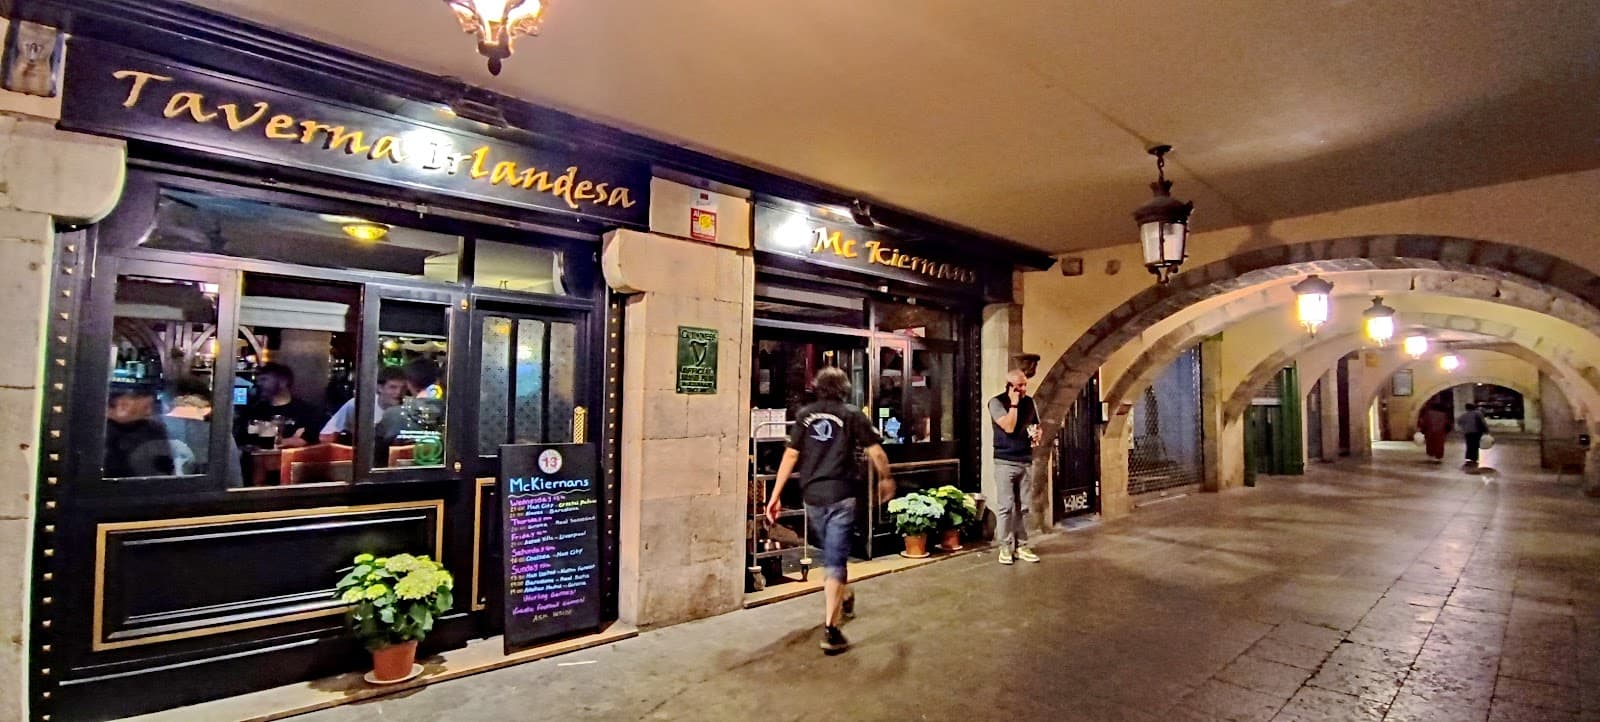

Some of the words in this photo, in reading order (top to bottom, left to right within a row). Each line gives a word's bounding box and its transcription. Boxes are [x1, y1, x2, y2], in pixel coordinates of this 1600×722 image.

[112, 69, 409, 163] Taverna
[422, 142, 636, 209] Irlandesa
[811, 227, 858, 258] Mc
[510, 476, 589, 493] McKiernans
[511, 532, 535, 541] Friday
[511, 564, 538, 575] Sunday
